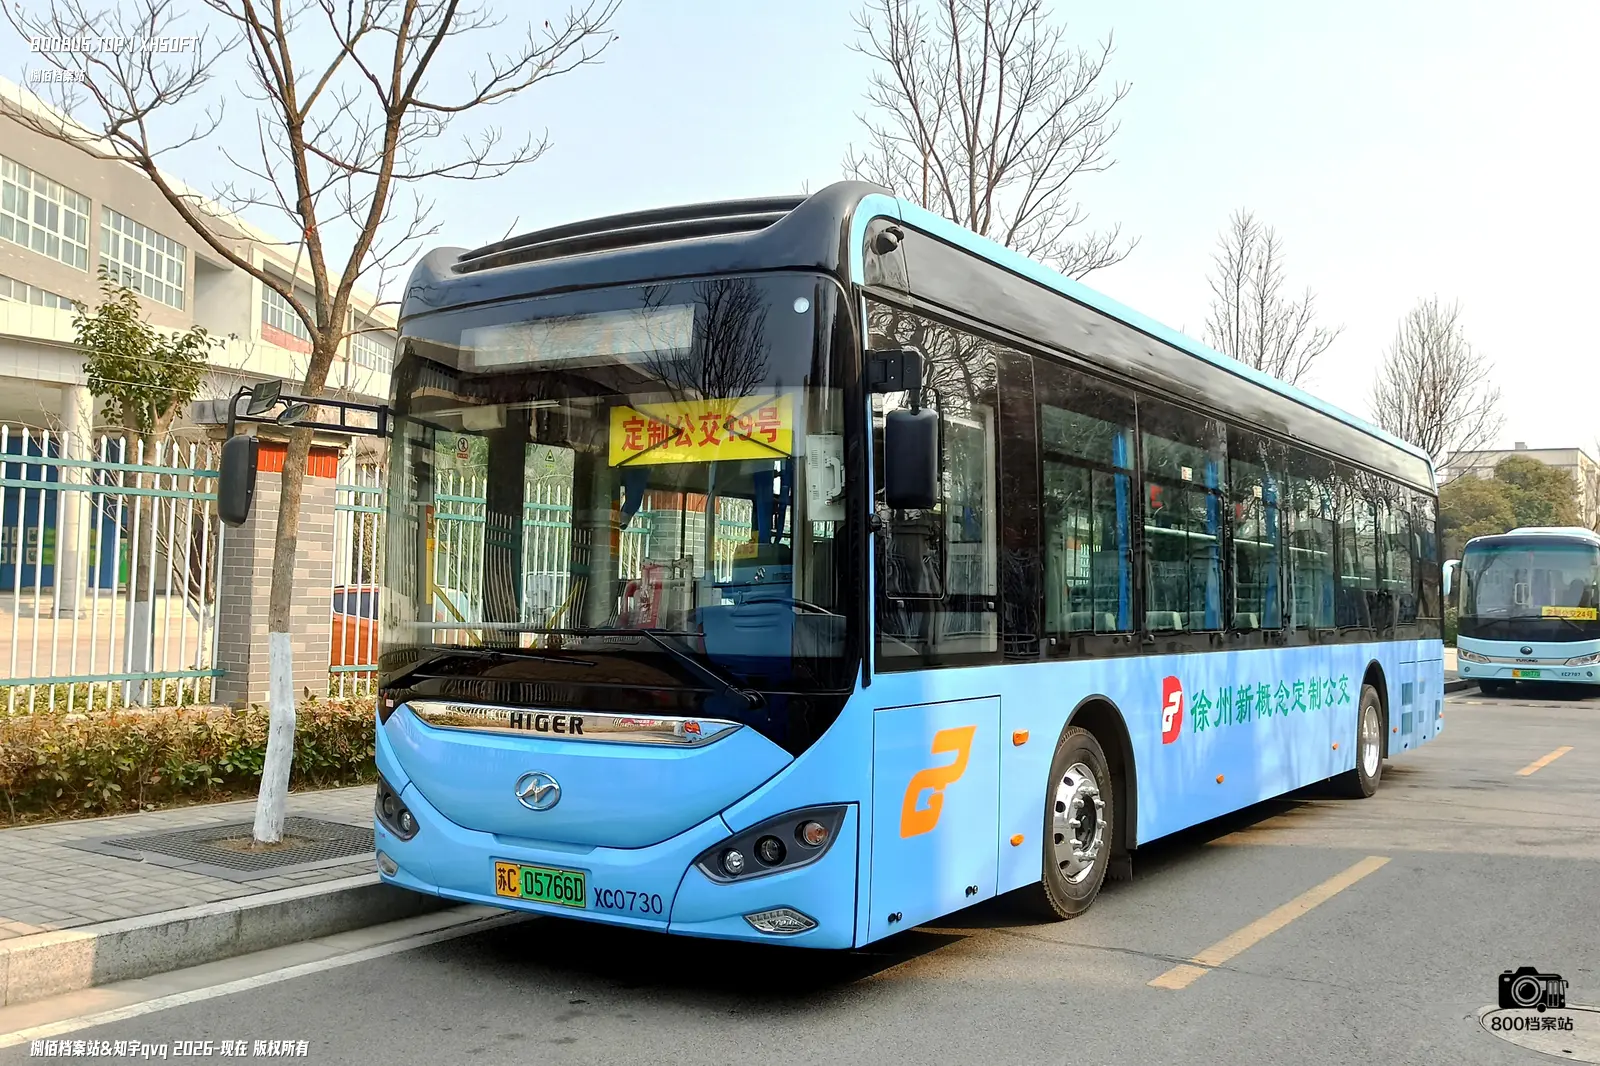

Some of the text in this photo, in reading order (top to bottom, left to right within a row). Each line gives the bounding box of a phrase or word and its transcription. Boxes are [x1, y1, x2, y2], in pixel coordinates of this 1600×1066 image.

[622, 407, 781, 451] 定制公交19号
[1190, 674, 1350, 733] 徐州新概念定制公交
[510, 712, 584, 735] HIGER
[593, 887, 663, 914] XC0730
